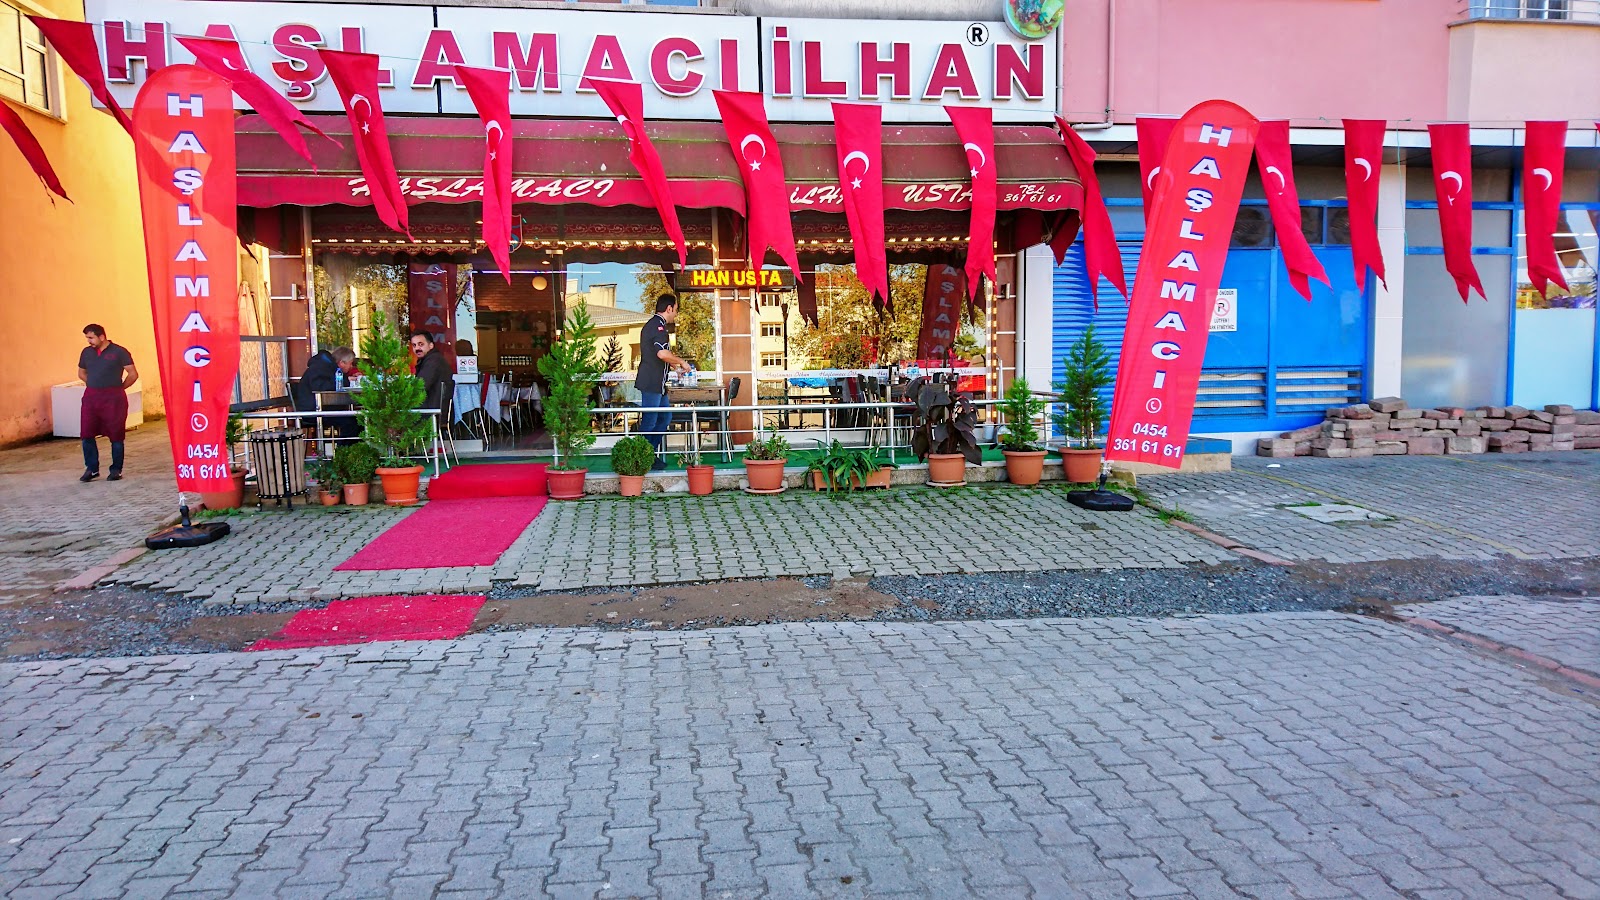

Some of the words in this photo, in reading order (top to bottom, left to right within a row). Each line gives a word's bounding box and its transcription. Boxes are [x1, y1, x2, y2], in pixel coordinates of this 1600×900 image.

[102, 20, 740, 101] HŞLAMACI
[771, 26, 1046, 100] İLHAN
[903, 184, 973, 204] USTA
[1003, 193, 1027, 203] 361
[1030, 193, 1044, 203] 61
[1047, 194, 1062, 203] 61
[167, 93, 211, 402] HAŞLAMACI
[1151, 123, 1233, 390] HAŞLAMACI
[691, 270, 730, 286] HAN
[733, 270, 783, 286] USTA
[1132, 422, 1168, 438] 0454
[187, 443, 219, 459] 0454
[1113, 438, 1137, 451] 361
[1141, 440, 1158, 454] 61
[1163, 444, 1182, 458] 61
[178, 463, 195, 479] 361
